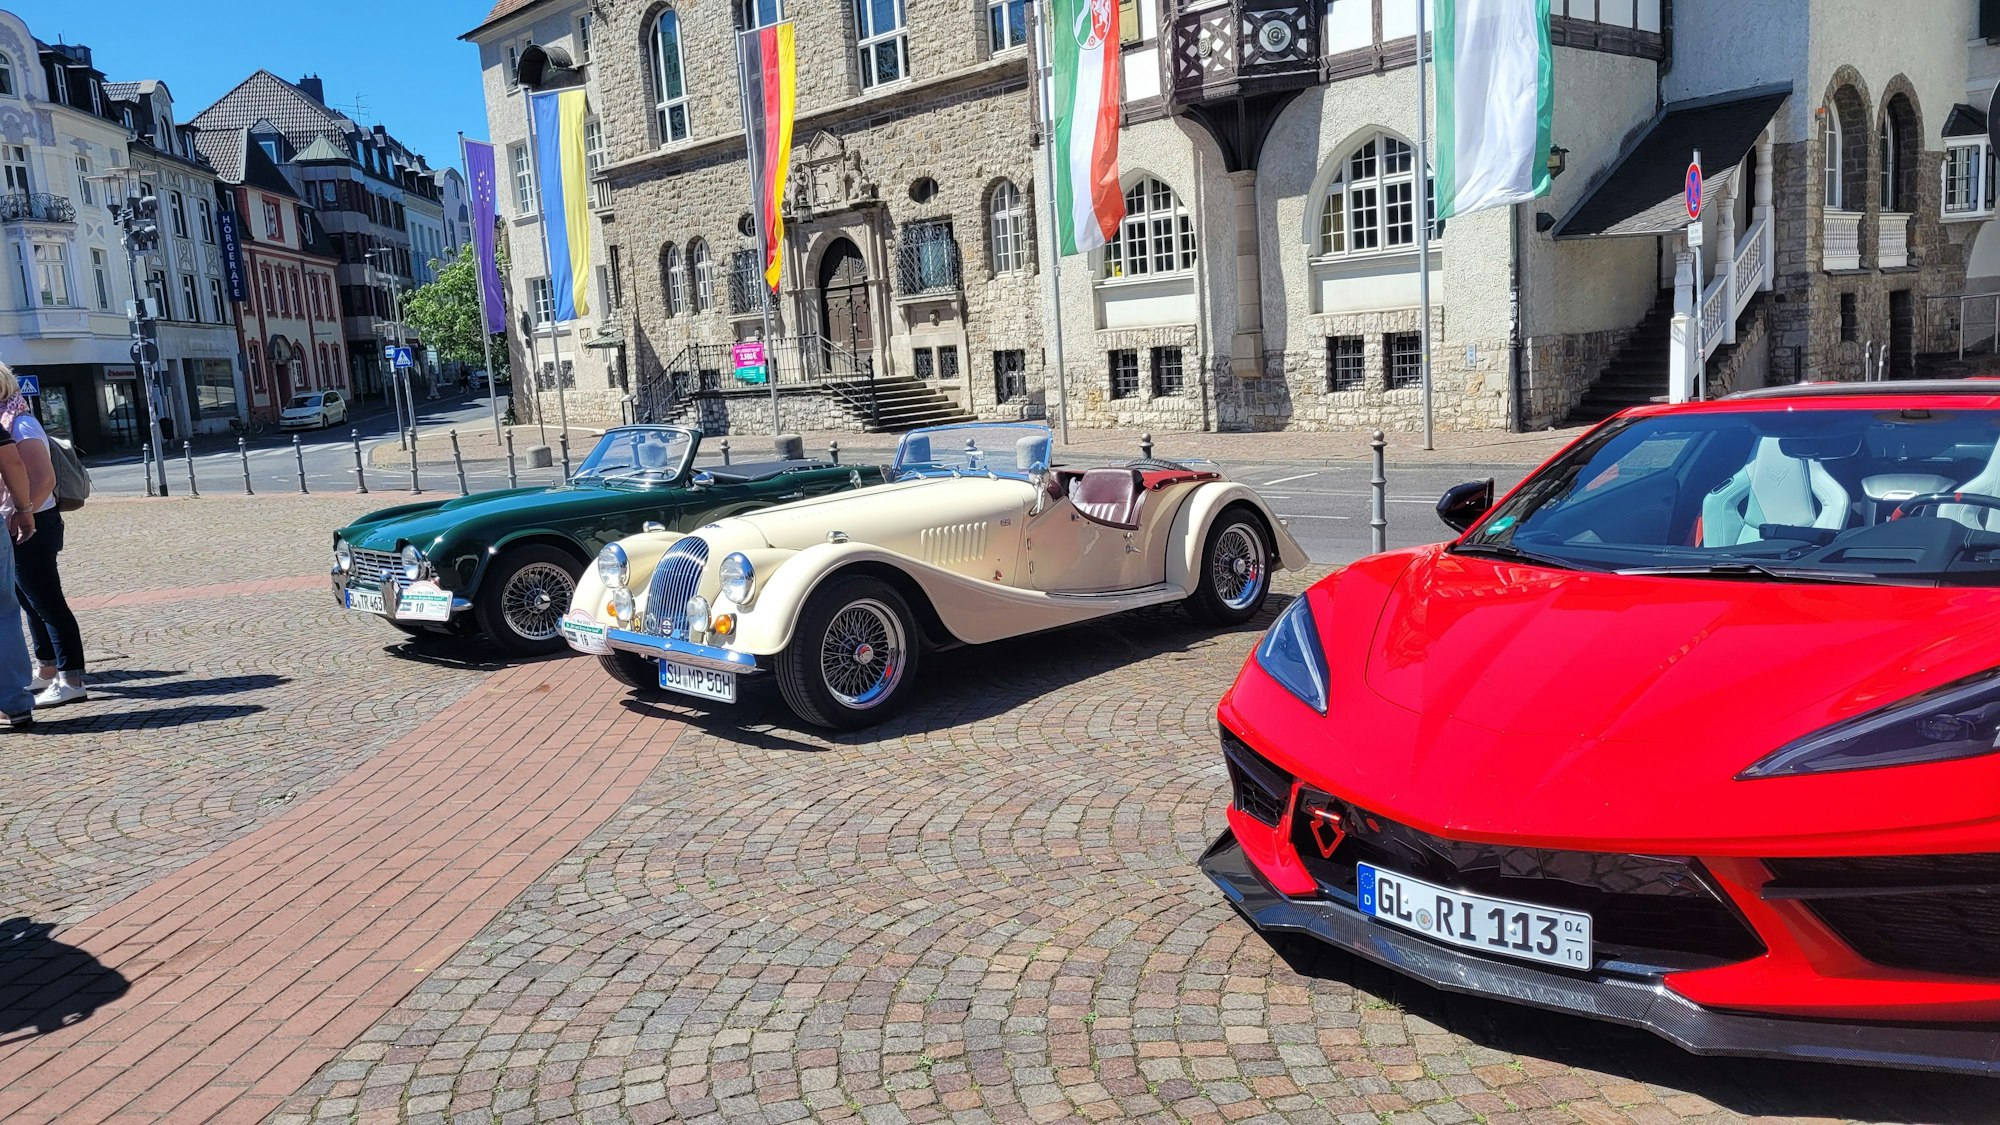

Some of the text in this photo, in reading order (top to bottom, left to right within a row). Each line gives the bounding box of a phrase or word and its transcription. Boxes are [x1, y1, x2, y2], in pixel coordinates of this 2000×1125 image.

[222, 215, 240, 297] HÖRGERÄTE
[360, 594, 369, 610] TR
[370, 596, 383, 611] 463
[415, 602, 425, 613] 10
[580, 633, 589, 646] 16
[667, 663, 731, 696] SU MP 50H
[1364, 894, 1372, 906] D
[1377, 877, 1559, 956] GL RI 113
[1564, 920, 1583, 934] 04
[1566, 948, 1583, 962] 10
